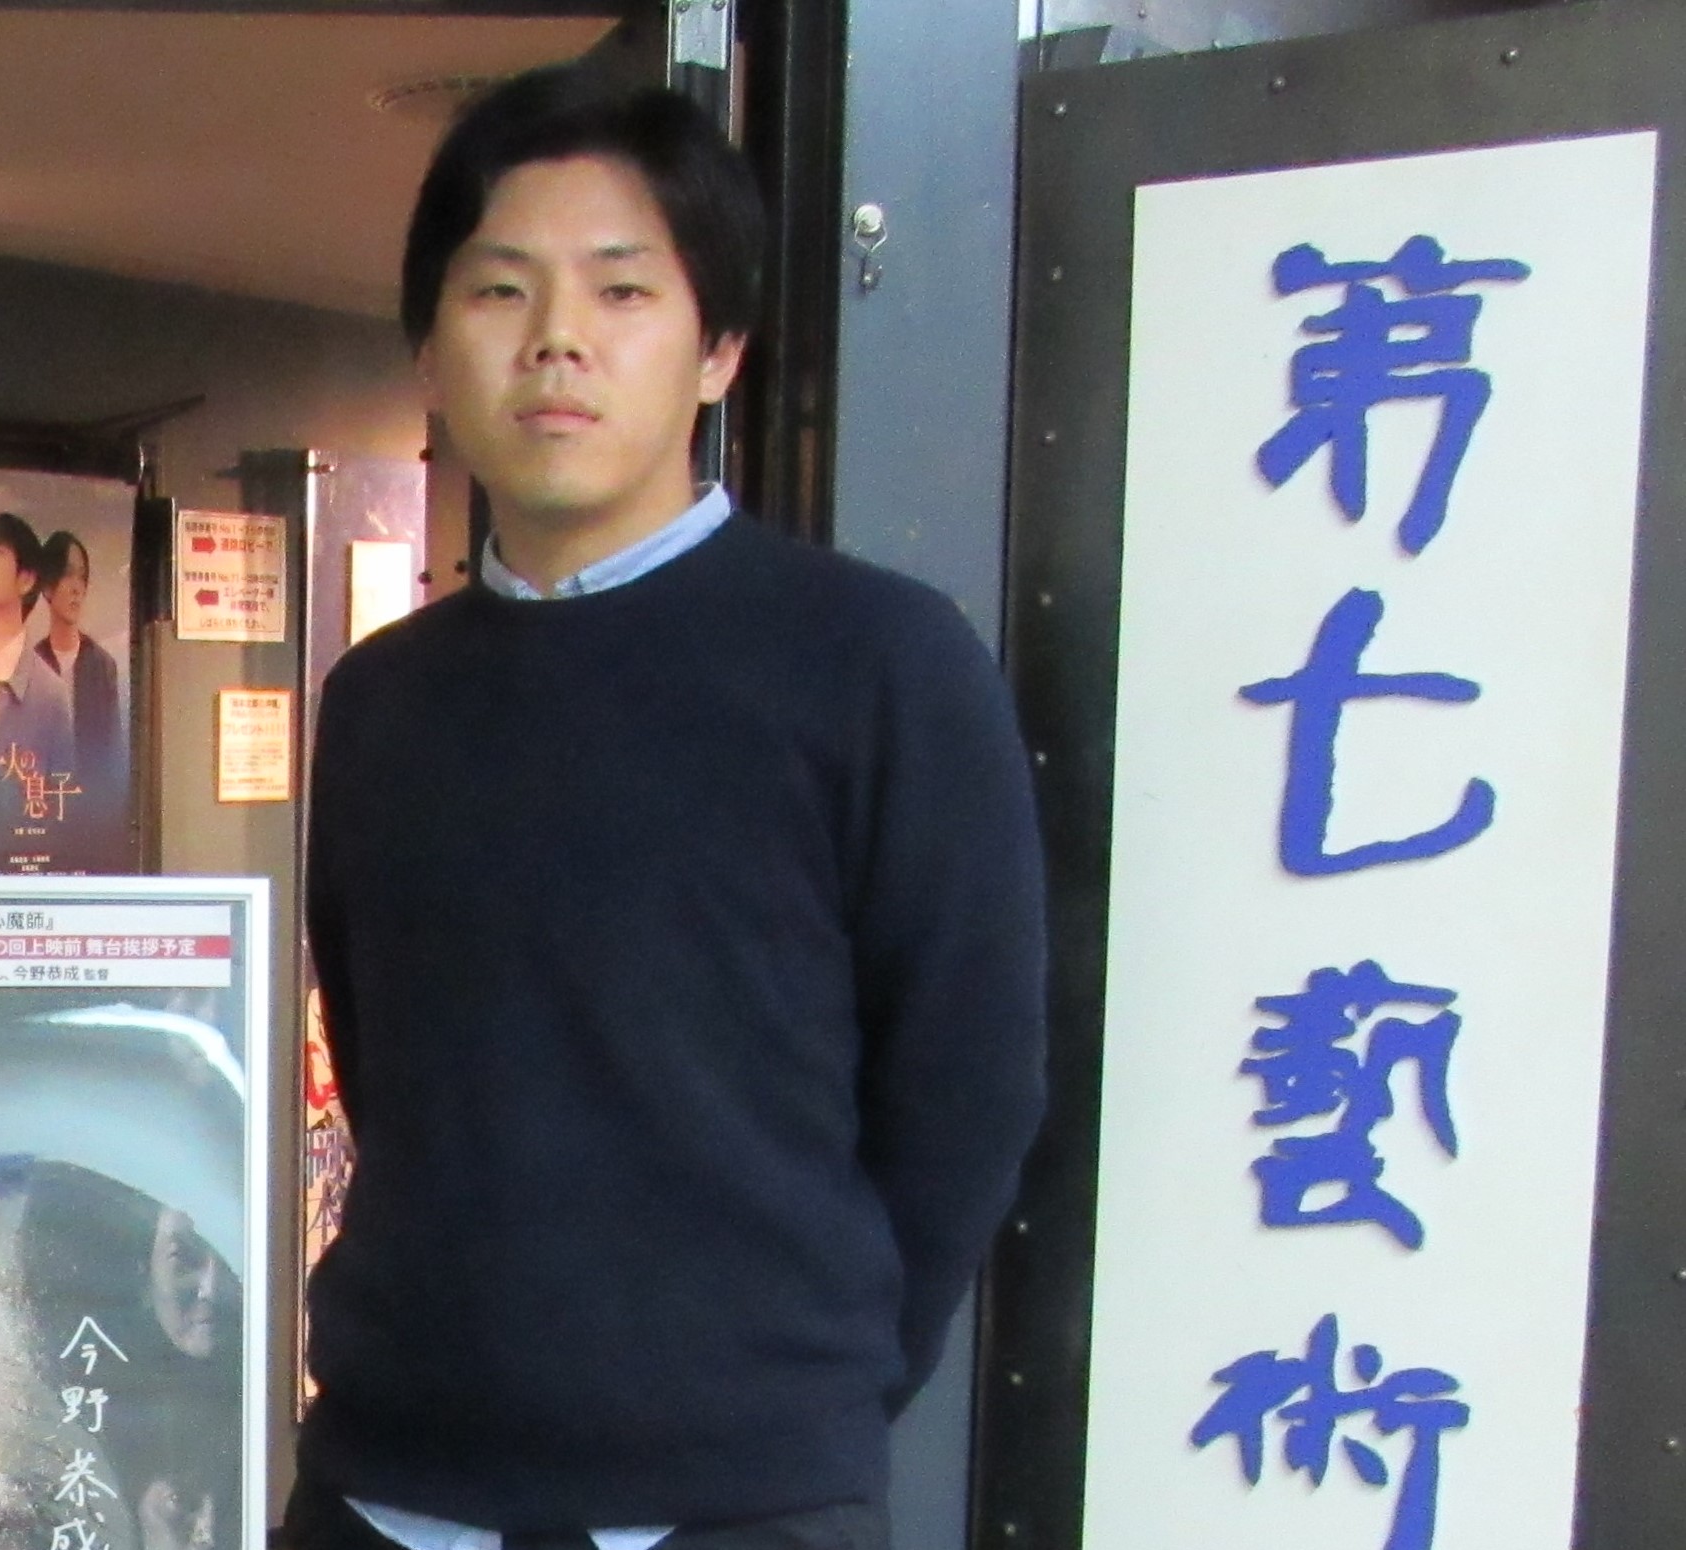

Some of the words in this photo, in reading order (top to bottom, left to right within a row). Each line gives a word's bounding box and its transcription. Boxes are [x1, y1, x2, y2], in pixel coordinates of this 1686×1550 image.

[86, 938, 196, 958] 舞台挨拶予定
